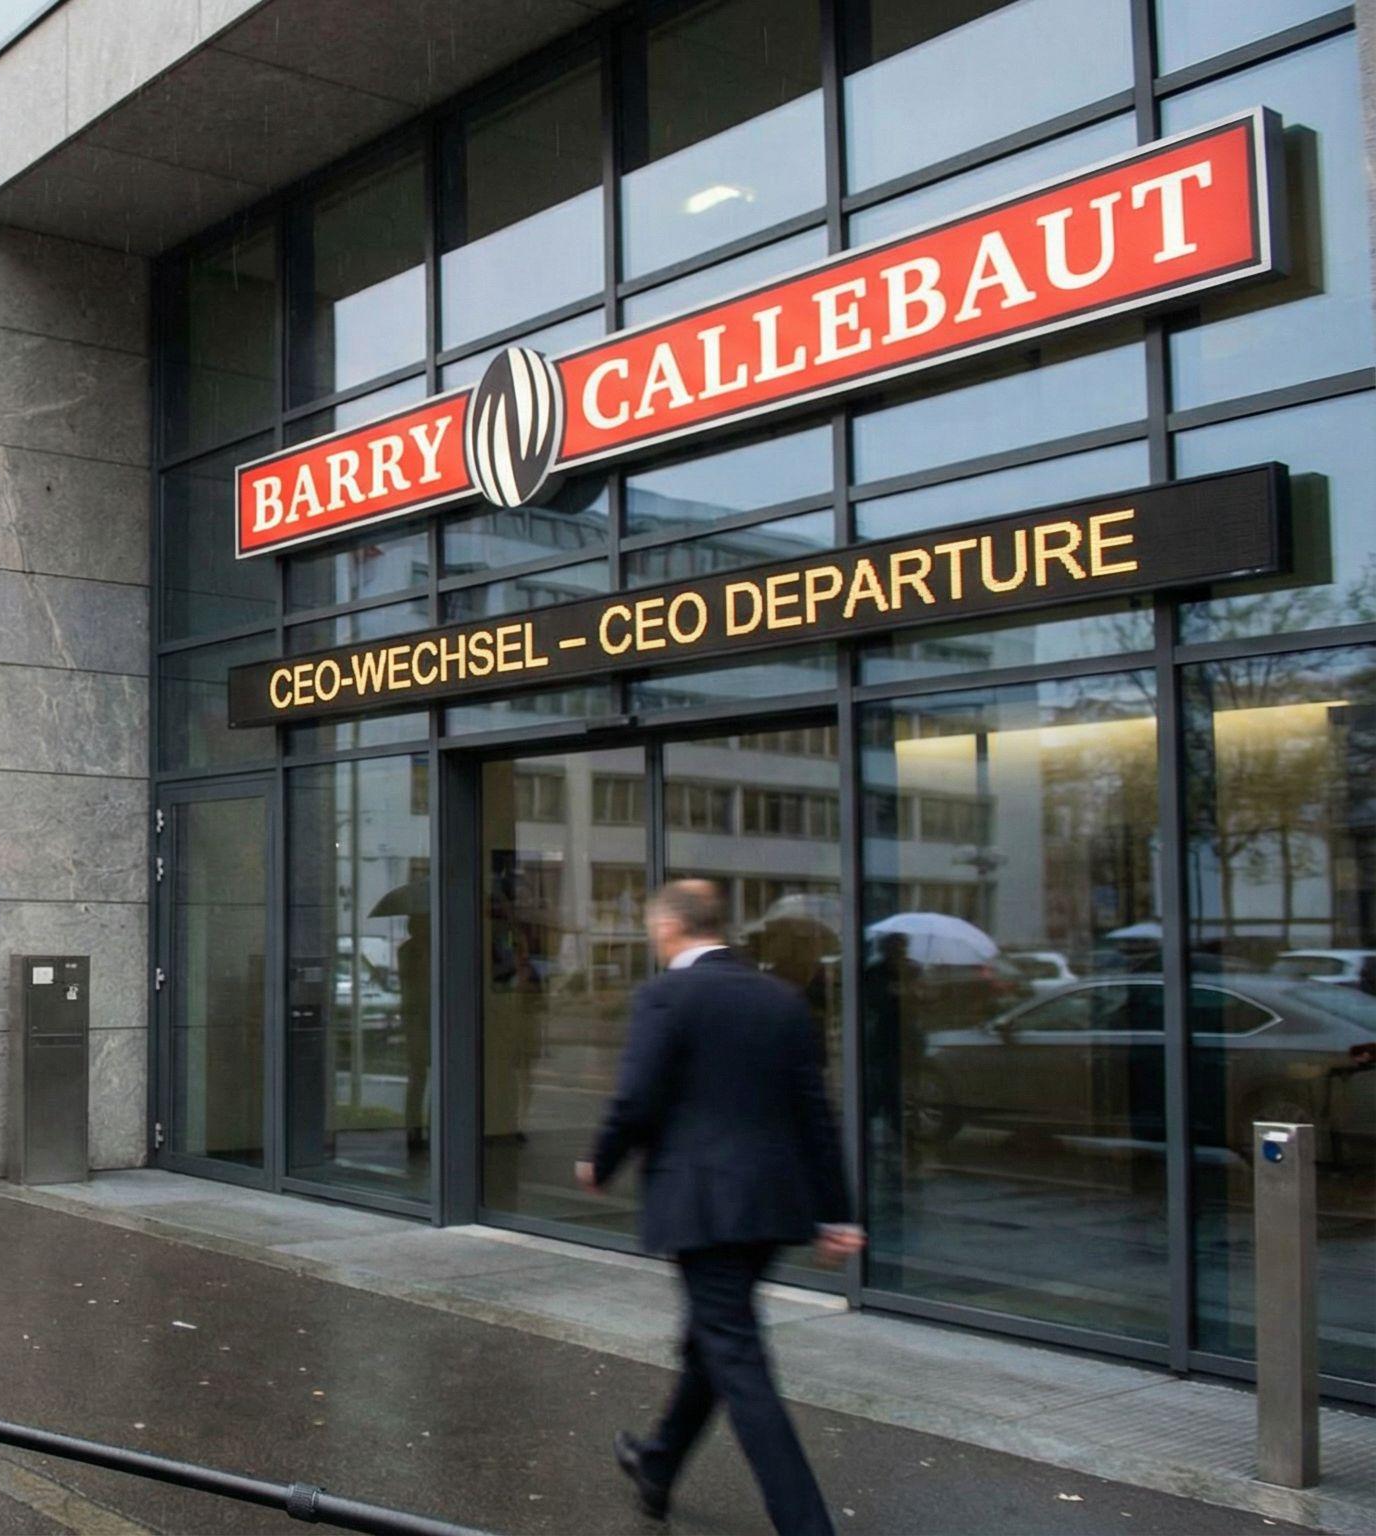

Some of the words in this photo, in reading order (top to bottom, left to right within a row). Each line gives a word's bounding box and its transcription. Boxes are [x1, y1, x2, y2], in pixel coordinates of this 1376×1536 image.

[252, 415, 453, 533] BARRY
[582, 160, 1213, 430] CALLEBAUT
[270, 622, 549, 709] CEO-WECHSEL
[600, 592, 708, 655] CEO
[725, 508, 1138, 637] DEPARTURE
